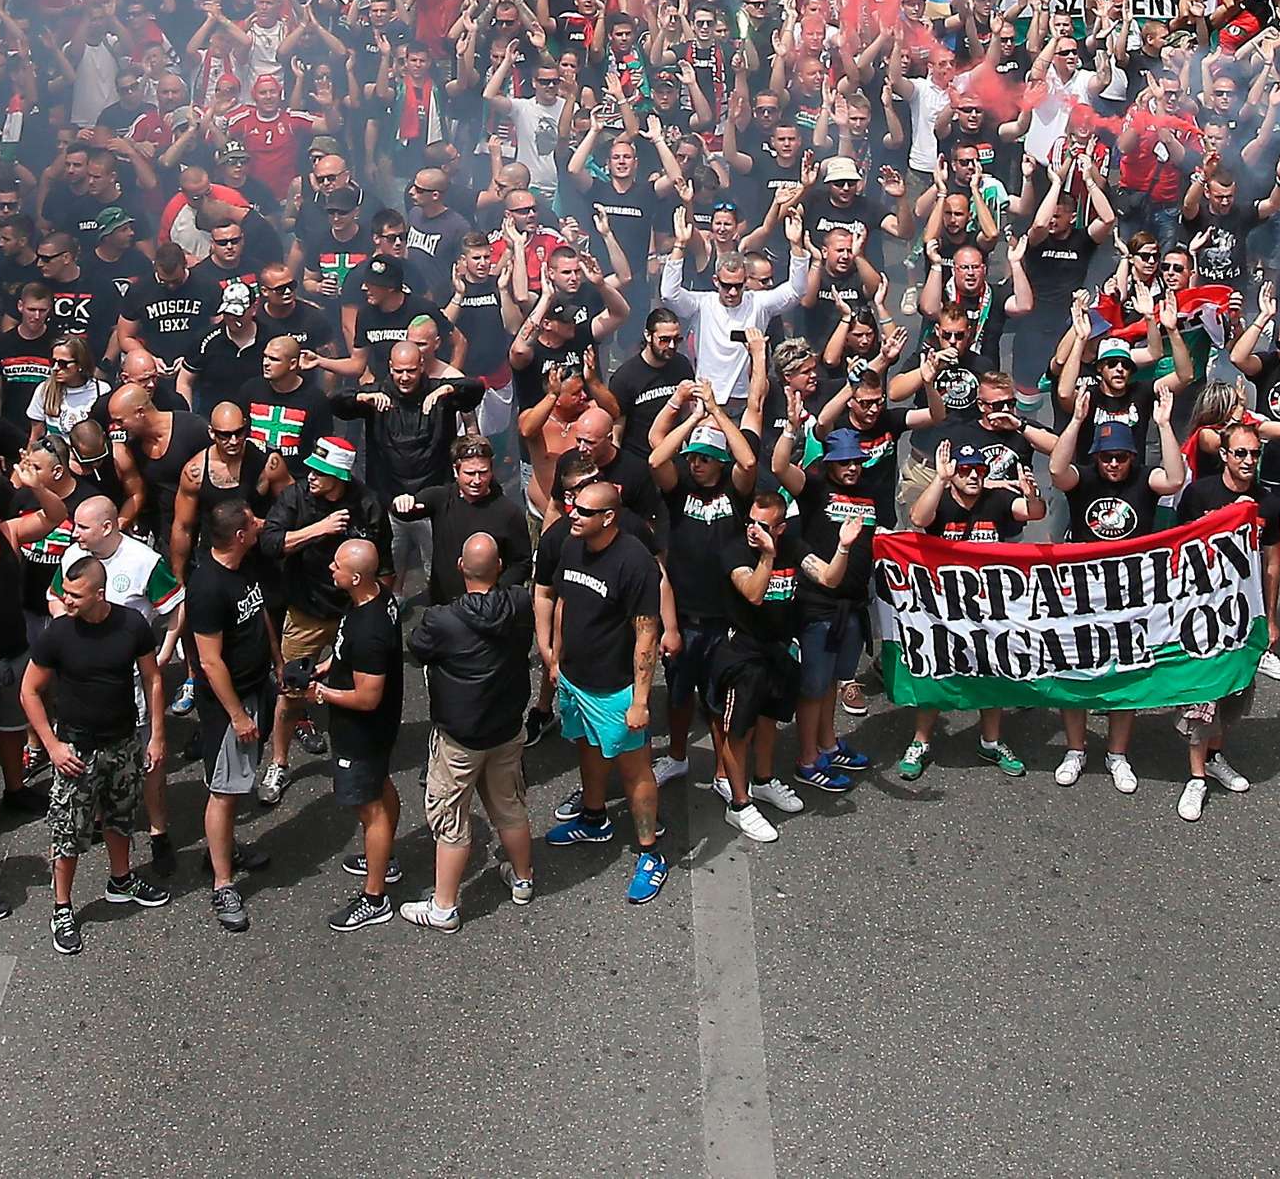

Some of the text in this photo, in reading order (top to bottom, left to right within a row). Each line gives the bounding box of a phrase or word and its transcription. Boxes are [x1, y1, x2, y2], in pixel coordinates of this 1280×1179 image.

[147, 299, 201, 319] MUSCLE
[159, 317, 190, 333] 19XX
[875, 524, 1254, 624] CARPATHIAN
[900, 617, 1153, 680] BRIGADE
